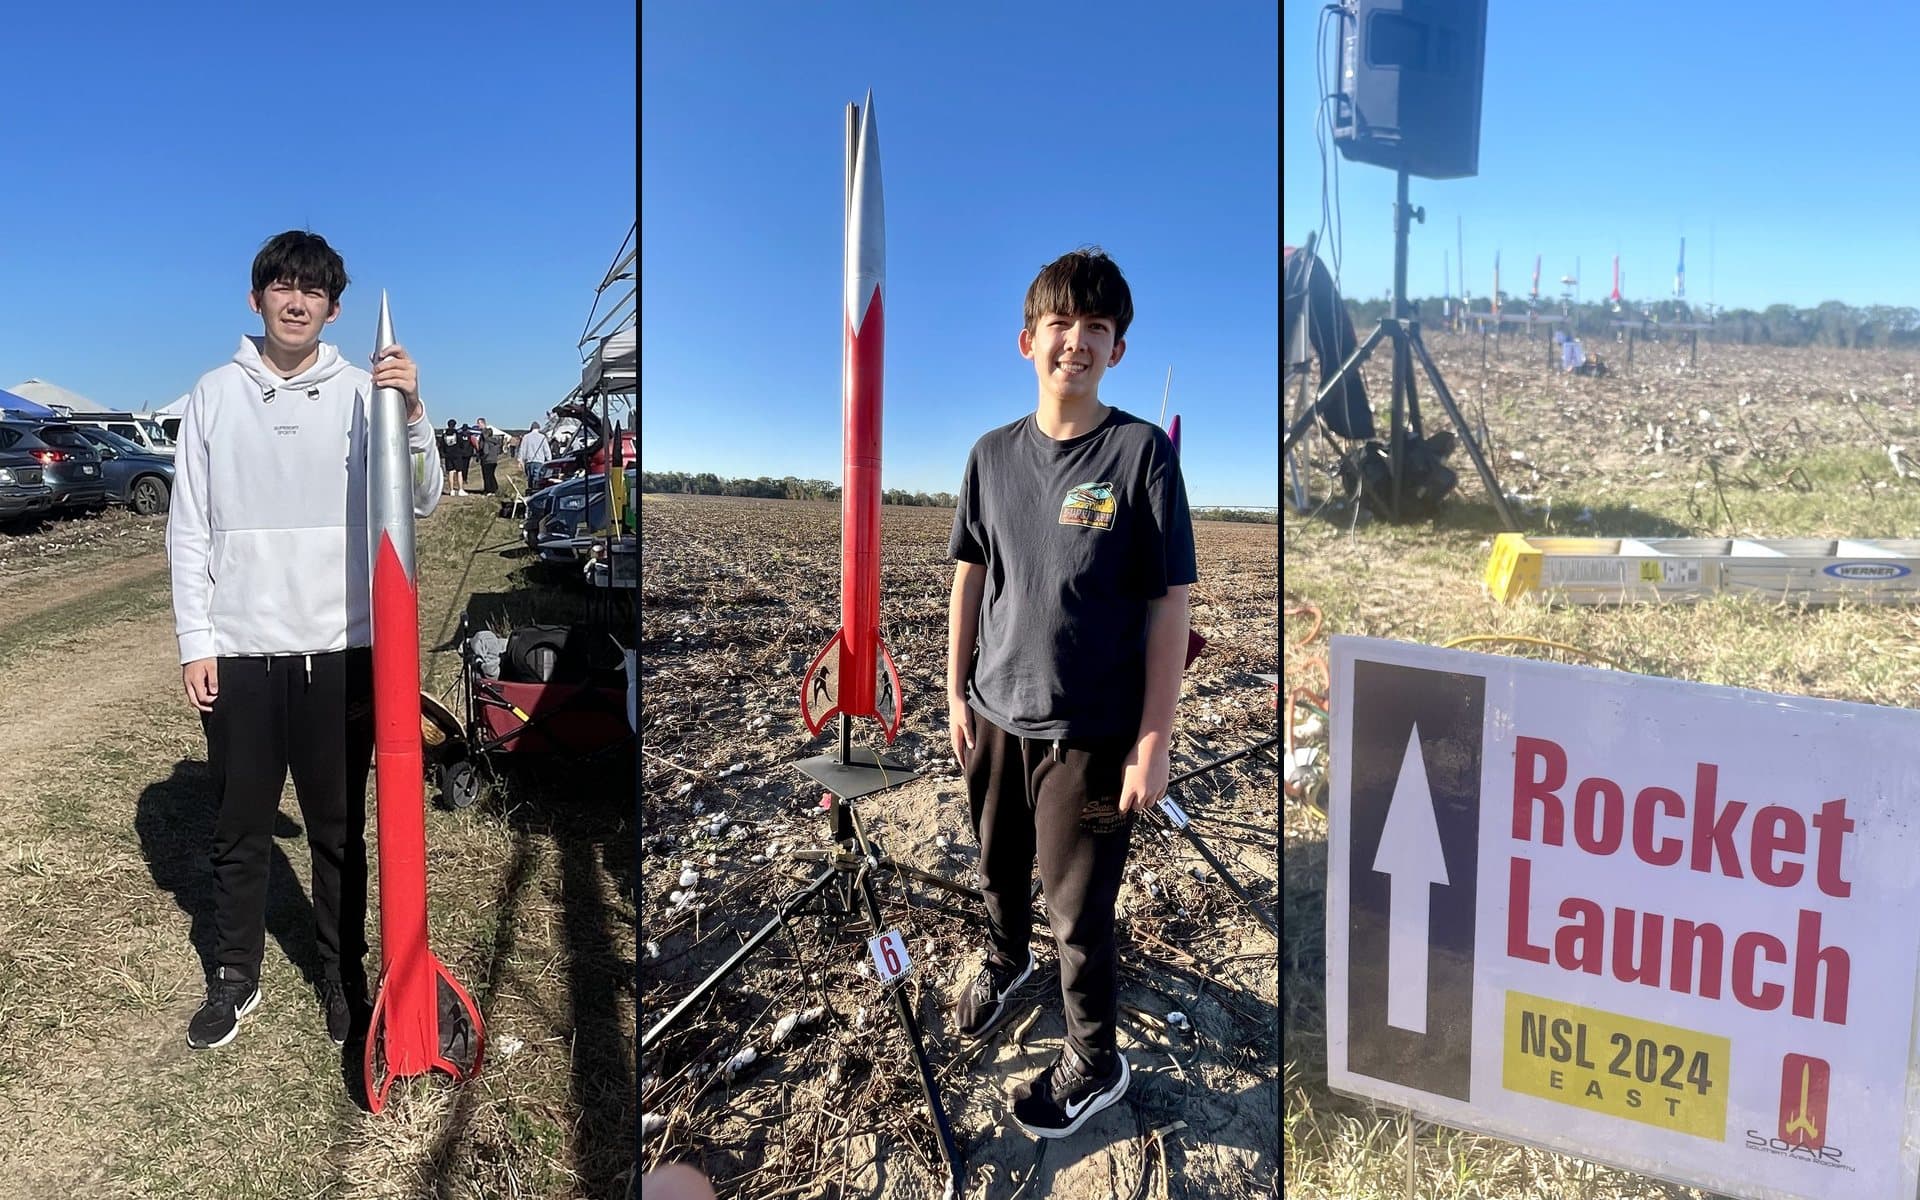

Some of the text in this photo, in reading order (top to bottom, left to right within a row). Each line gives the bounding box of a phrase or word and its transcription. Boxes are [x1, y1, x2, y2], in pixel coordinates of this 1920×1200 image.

[1840, 567, 1896, 577] WERNER
[1512, 735, 1855, 898] Rocket
[879, 935, 902, 976] 6
[1507, 856, 1851, 1026] Launch
[1520, 1010, 1713, 1095] NSL 2024
[1550, 1070, 1681, 1117] EAST
[1745, 1129, 1843, 1163] SOAR
